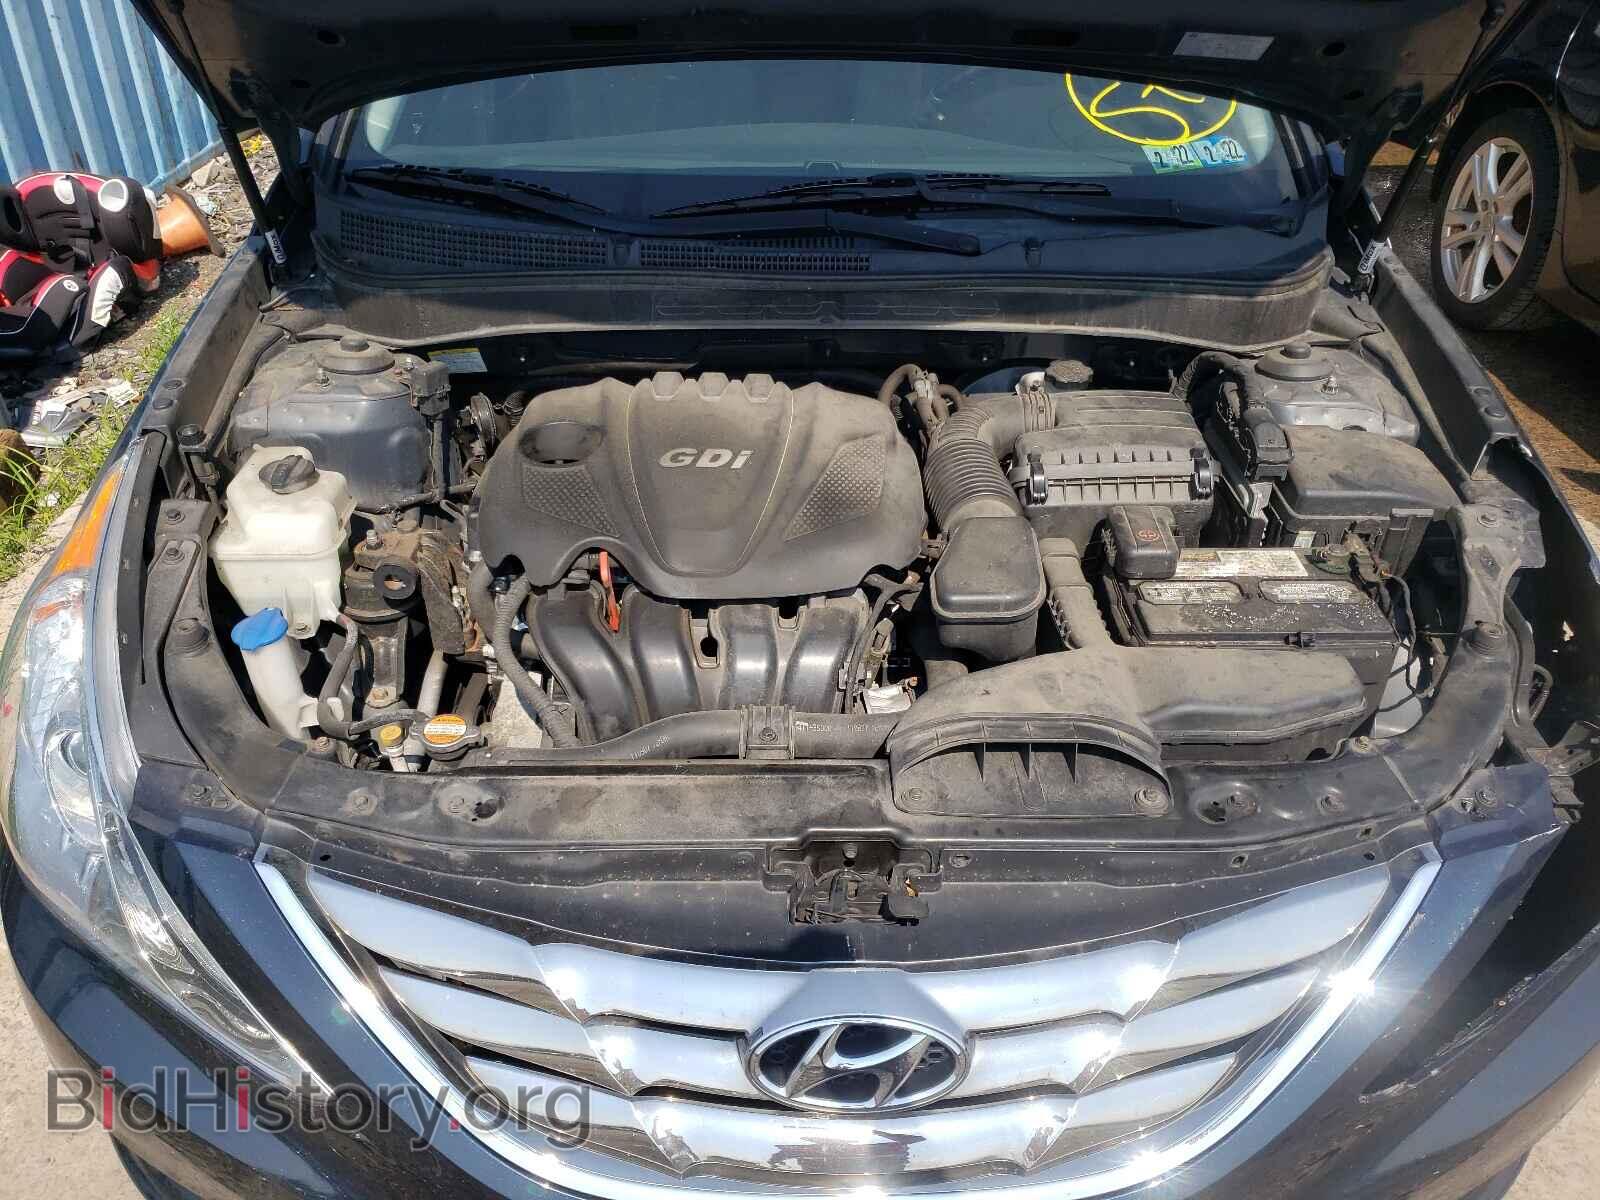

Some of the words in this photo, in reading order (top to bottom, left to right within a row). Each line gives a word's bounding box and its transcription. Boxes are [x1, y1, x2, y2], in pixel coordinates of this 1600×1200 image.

[1153, 151, 1169, 168] 2
[1172, 144, 1194, 163] 22
[1203, 145, 1218, 162] 2
[1222, 140, 1244, 159] 22
[658, 447, 754, 469] GDi
